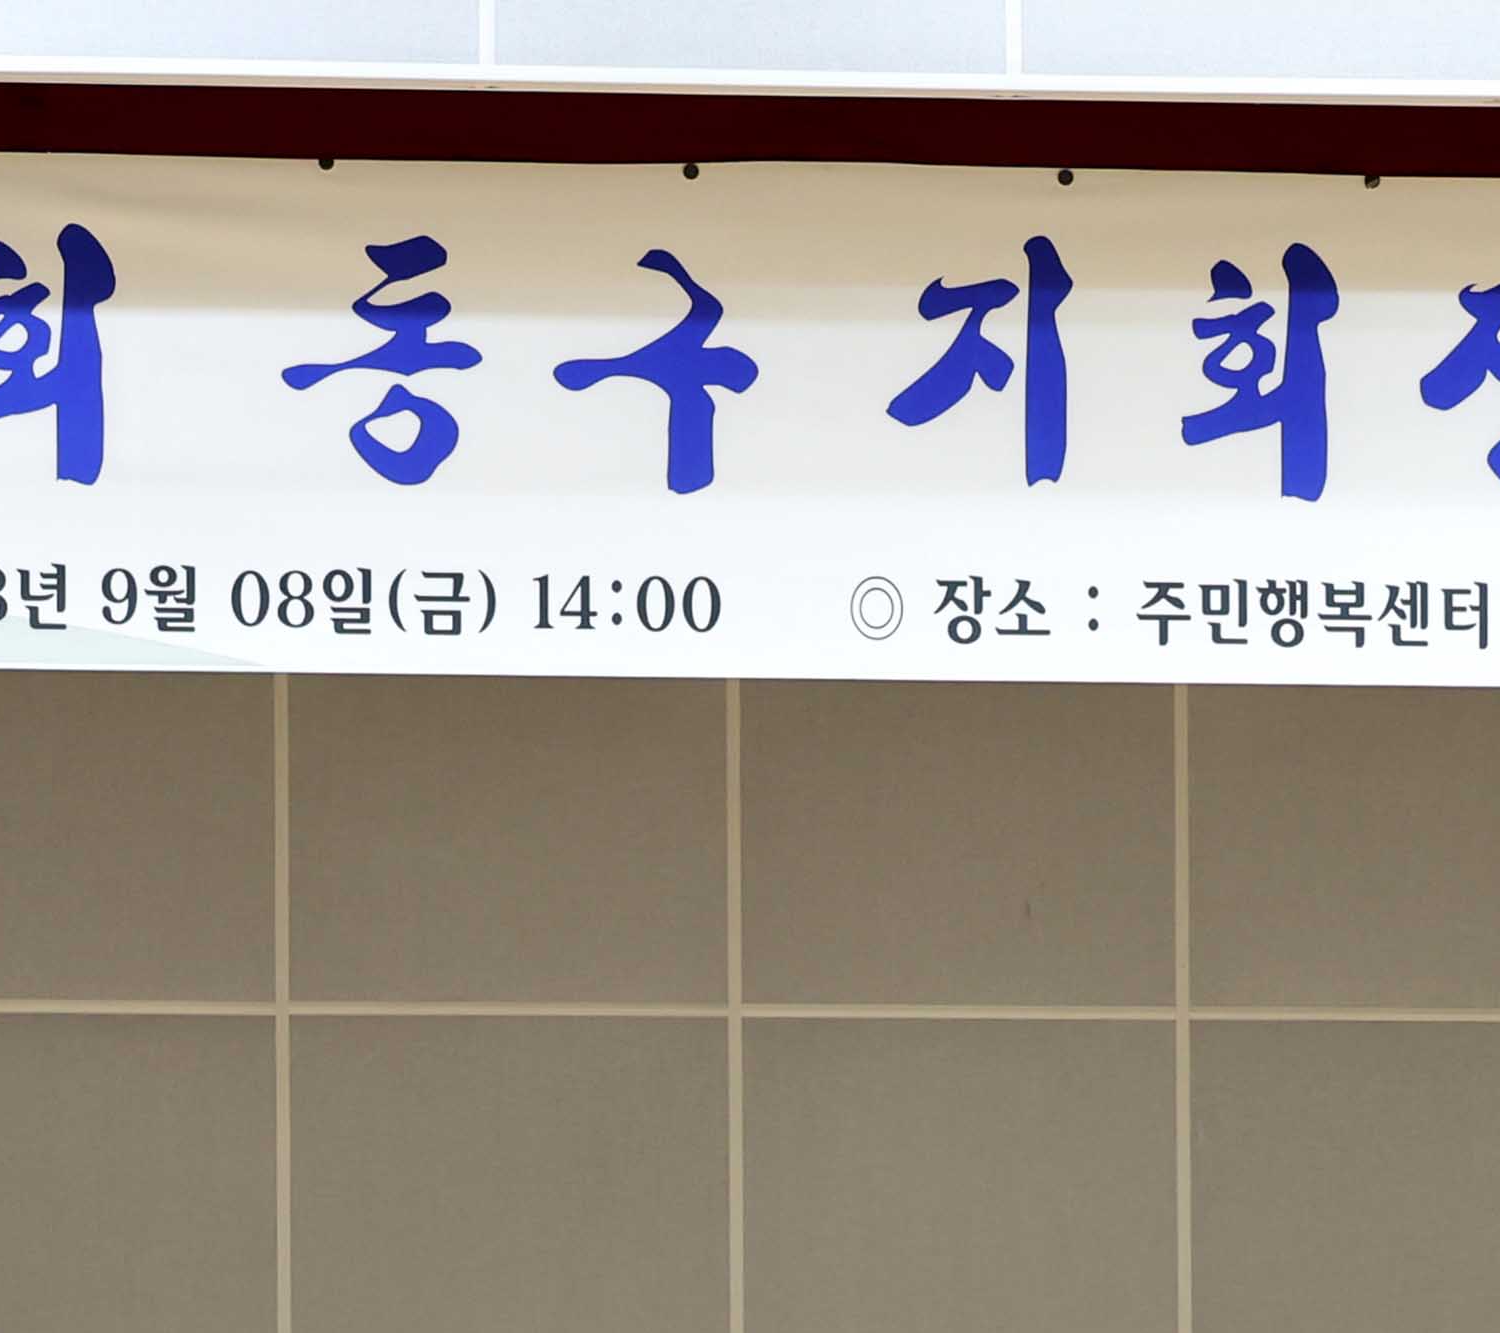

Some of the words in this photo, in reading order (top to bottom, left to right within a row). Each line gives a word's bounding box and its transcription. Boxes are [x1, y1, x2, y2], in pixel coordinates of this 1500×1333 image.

[100, 564, 197, 633] 9월
[230, 567, 497, 636] 08일(금)
[532, 573, 722, 634] 14:00
[933, 574, 1052, 645] 장소
[1135, 578, 1490, 650] 주민행복센터
